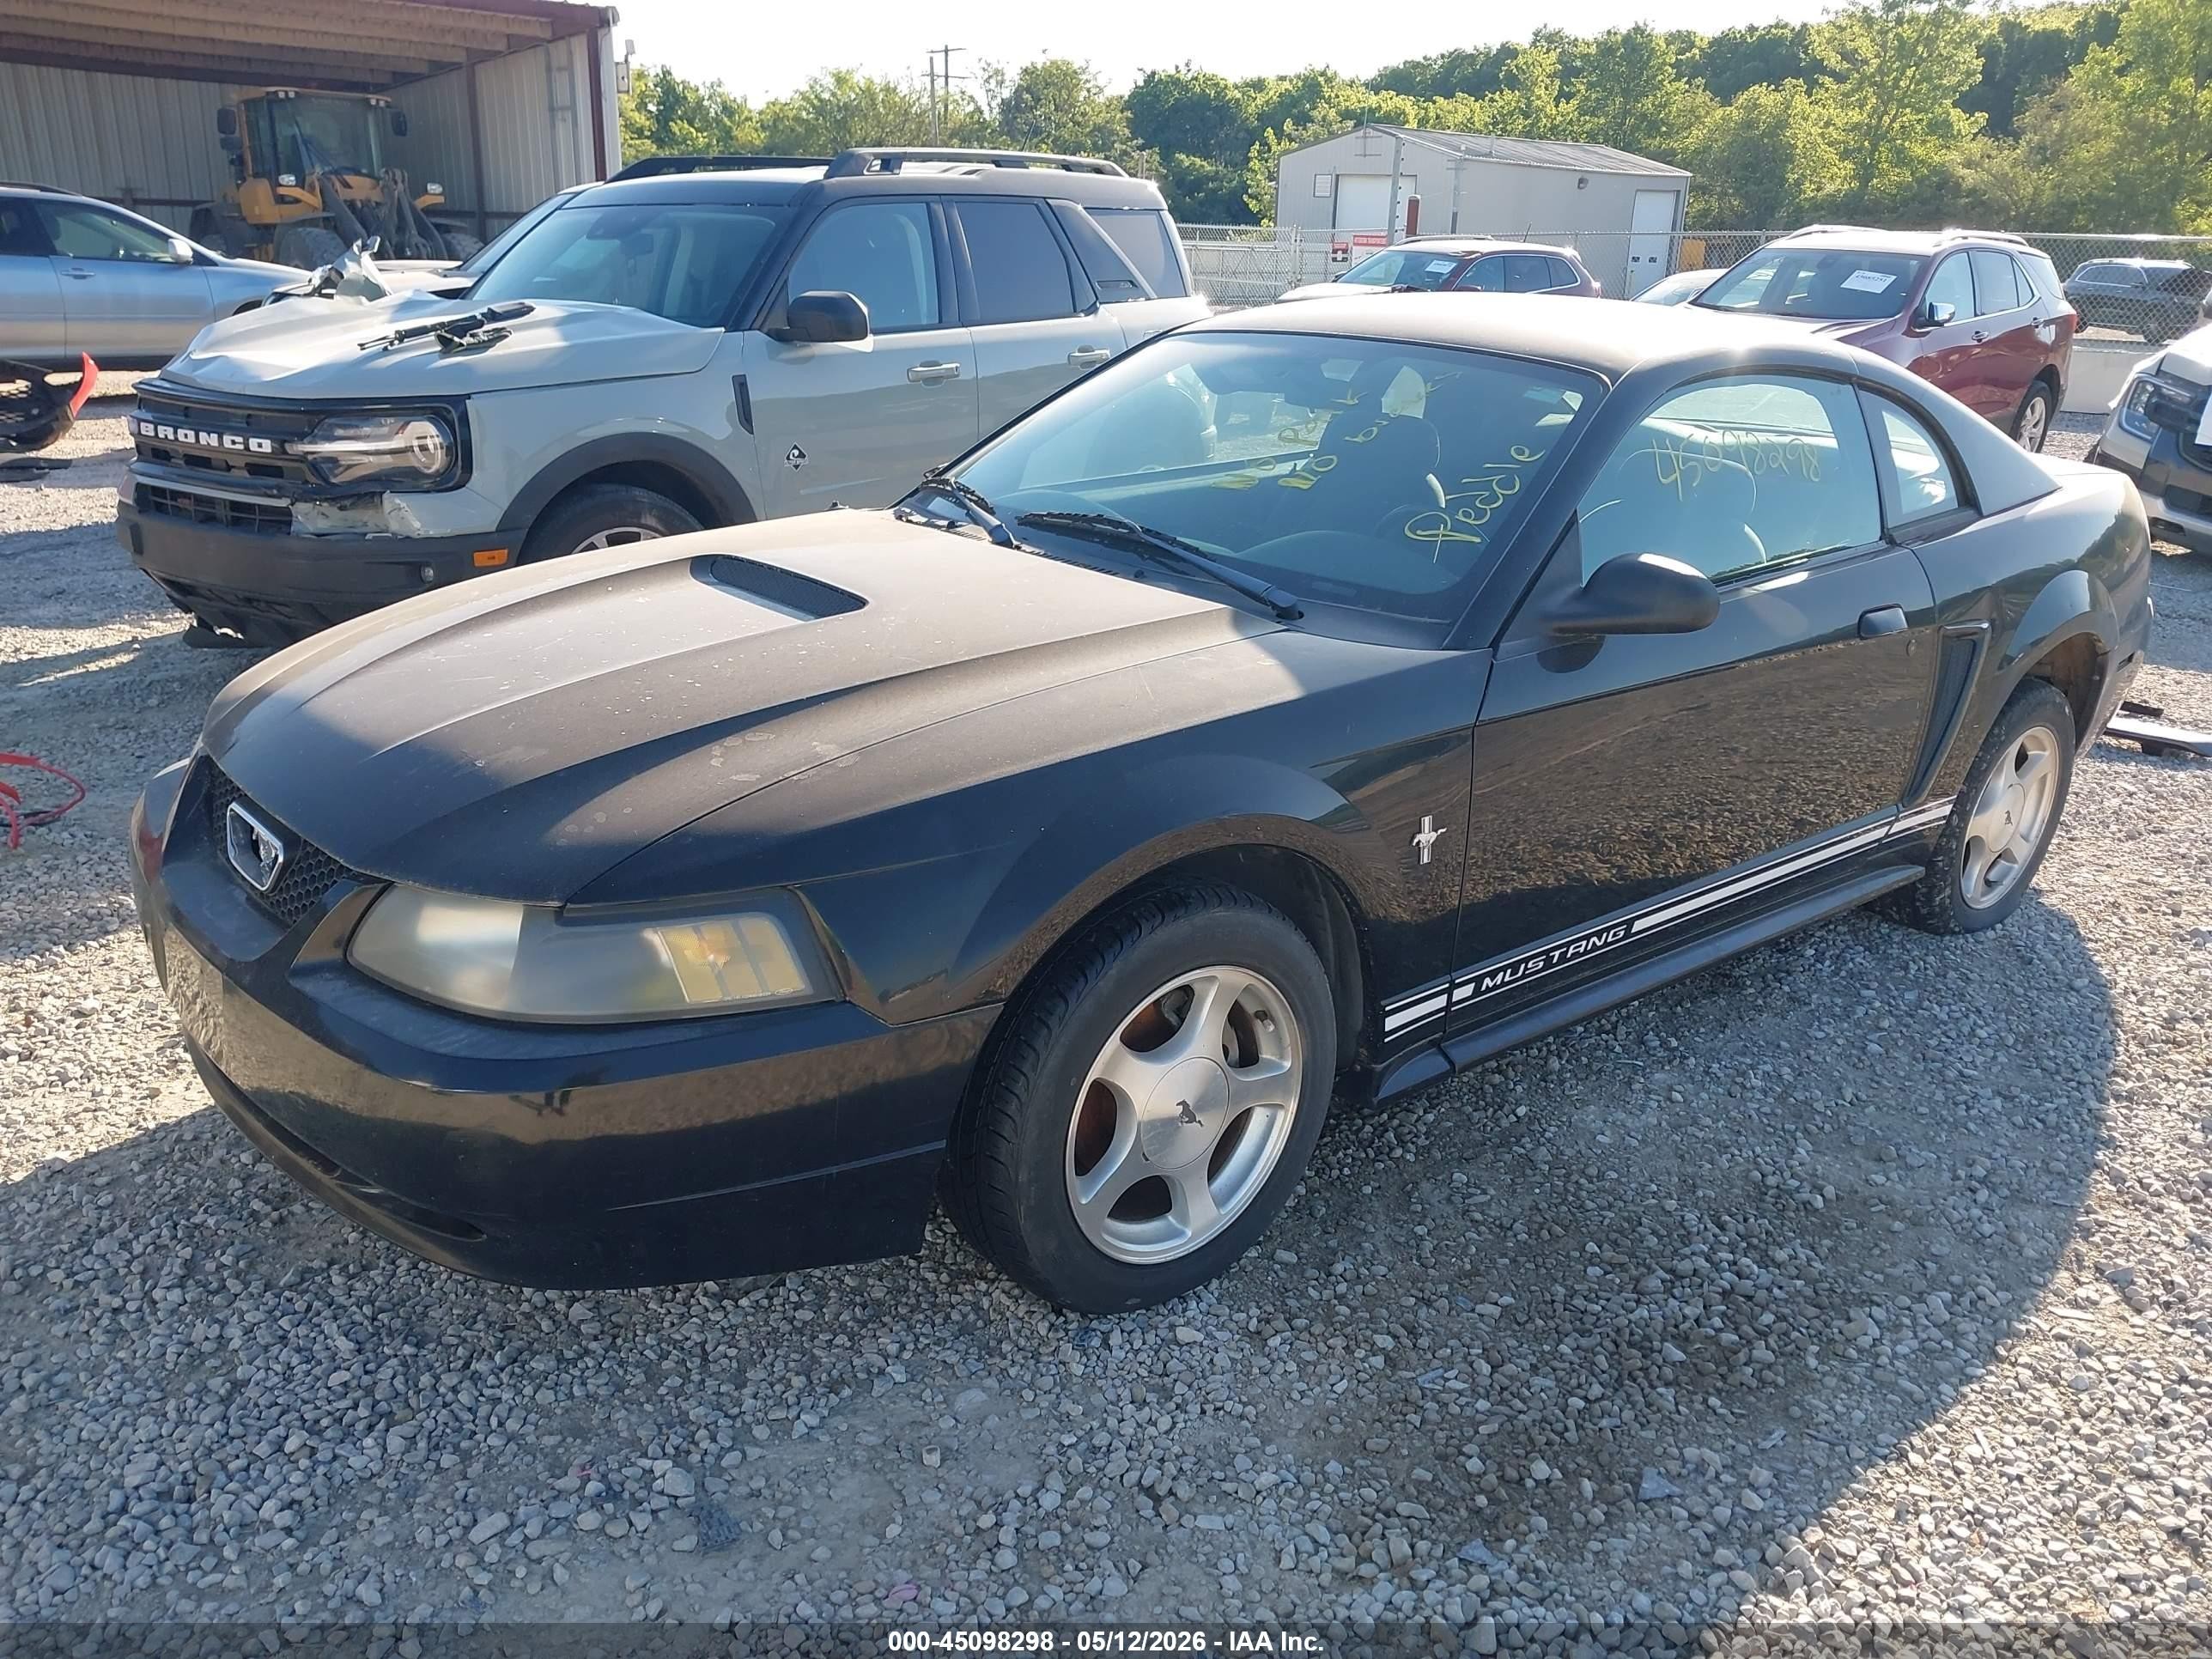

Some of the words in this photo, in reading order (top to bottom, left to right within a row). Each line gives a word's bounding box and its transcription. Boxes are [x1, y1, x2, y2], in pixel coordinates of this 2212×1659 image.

[139, 421, 272, 453] BRONCO
[1652, 428, 1821, 502] 45098298
[1404, 445, 1546, 543] Peddle
[1480, 924, 1628, 992] MUSTANG
